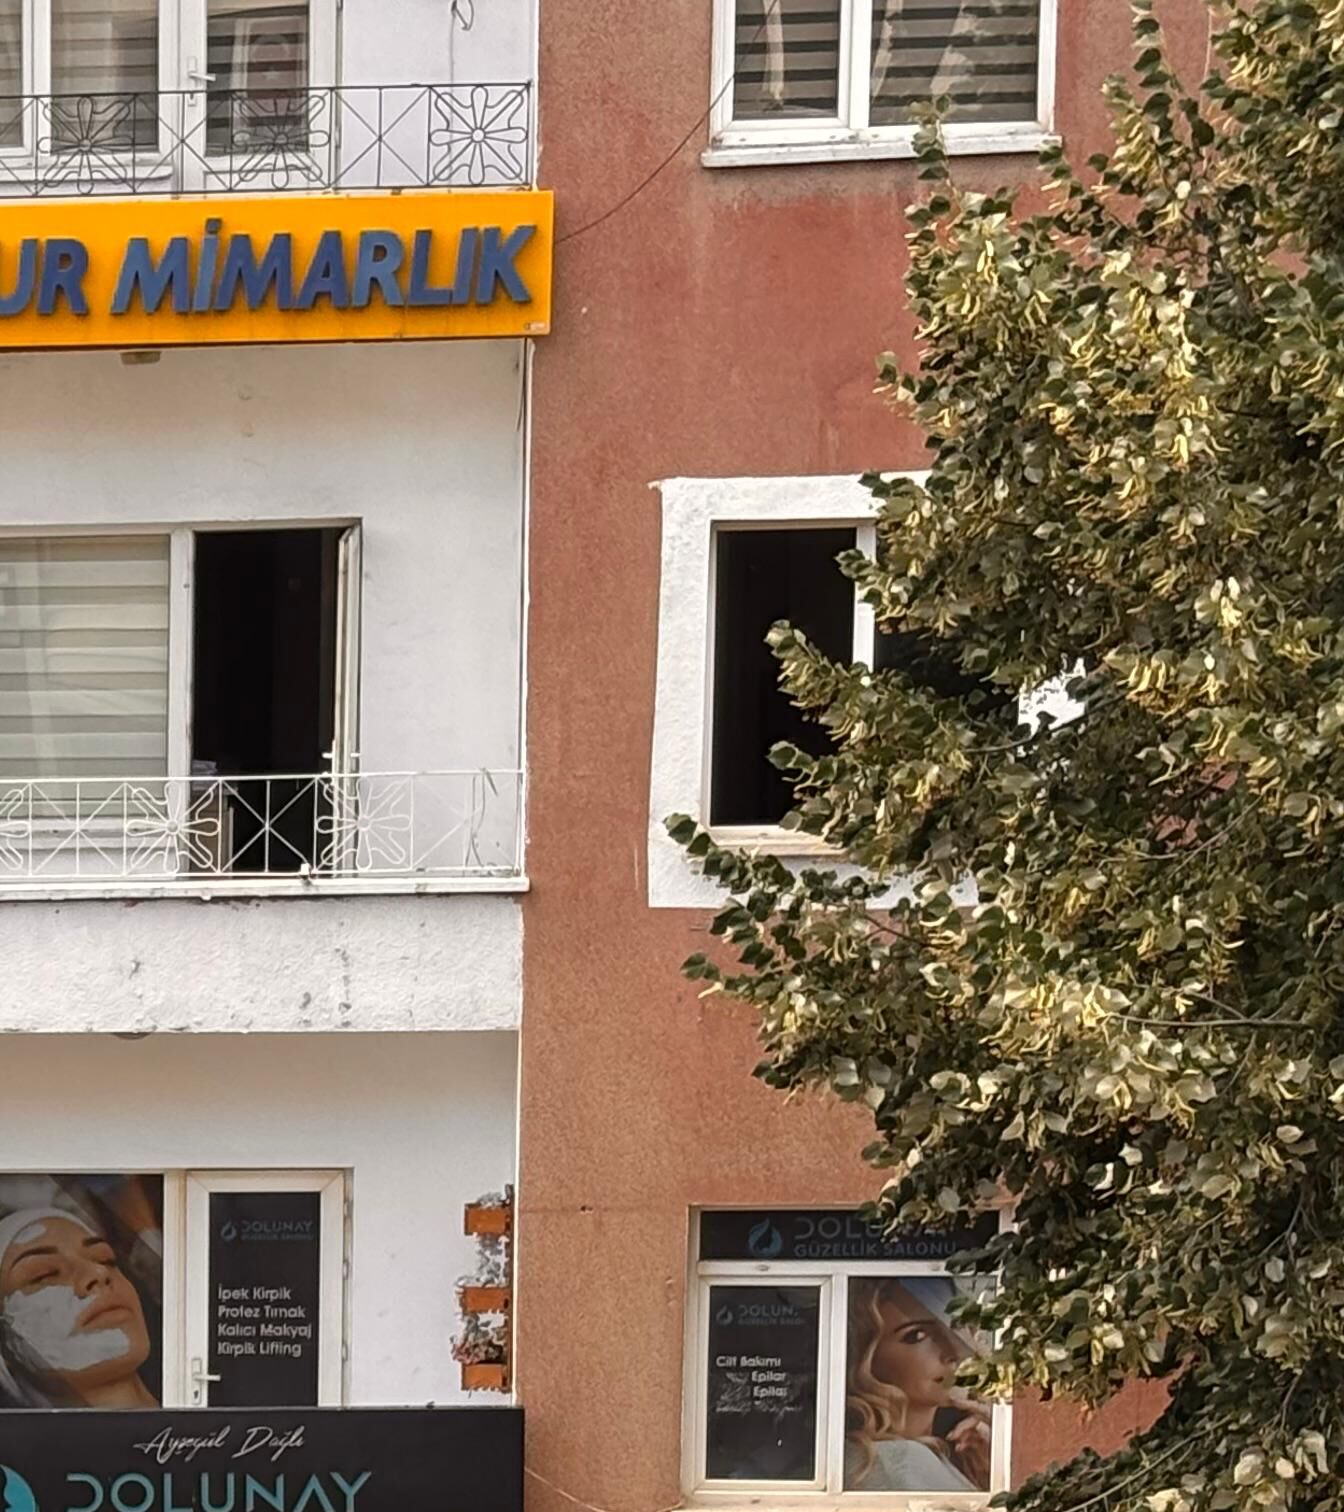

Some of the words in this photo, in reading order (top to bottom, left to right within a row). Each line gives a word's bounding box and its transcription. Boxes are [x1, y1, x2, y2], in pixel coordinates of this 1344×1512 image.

[111, 217, 537, 315] MİMARLIK
[218, 1283, 249, 1302] İpek
[253, 1285, 291, 1302] Kirpik
